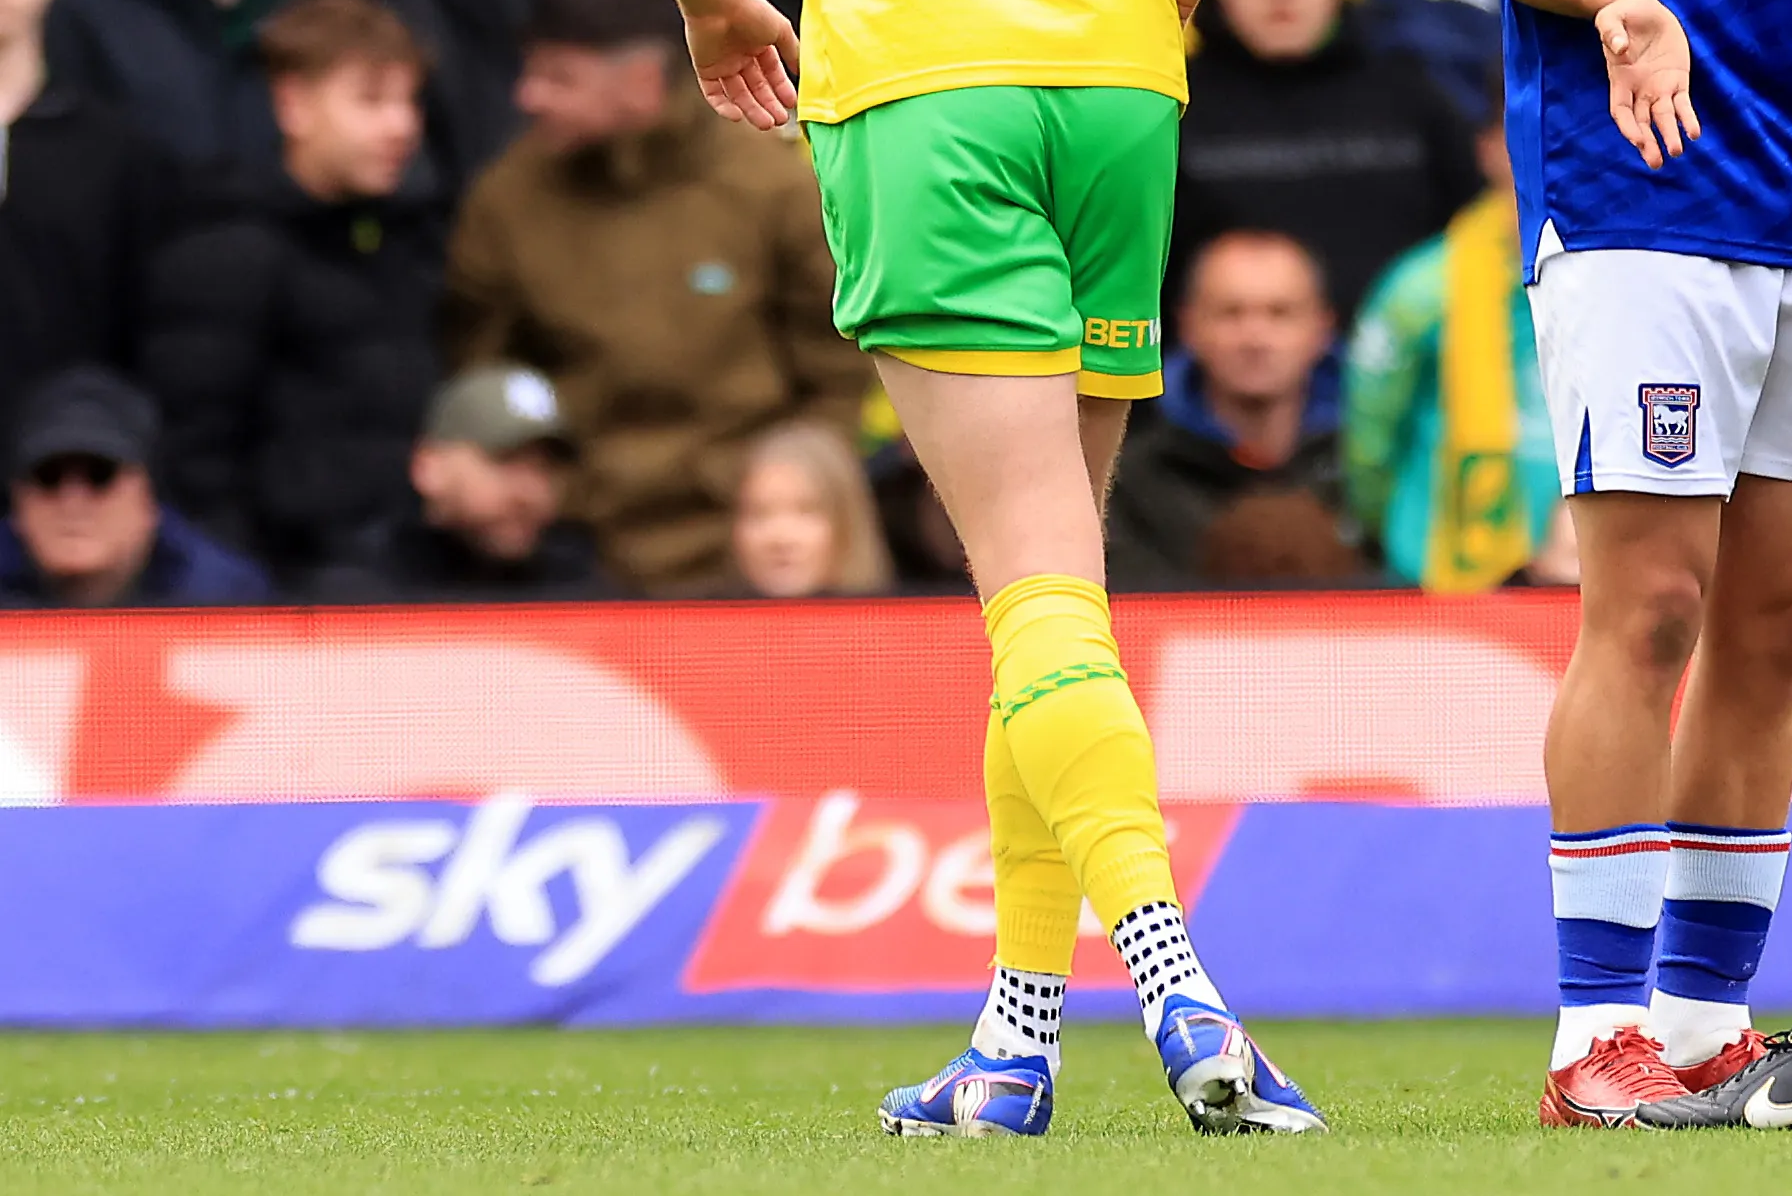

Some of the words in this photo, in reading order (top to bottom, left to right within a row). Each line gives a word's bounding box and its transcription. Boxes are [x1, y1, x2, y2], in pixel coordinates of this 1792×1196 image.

[1085, 317, 1161, 348] BETW
[289, 792, 727, 987] sky
[760, 788, 1178, 937] be
